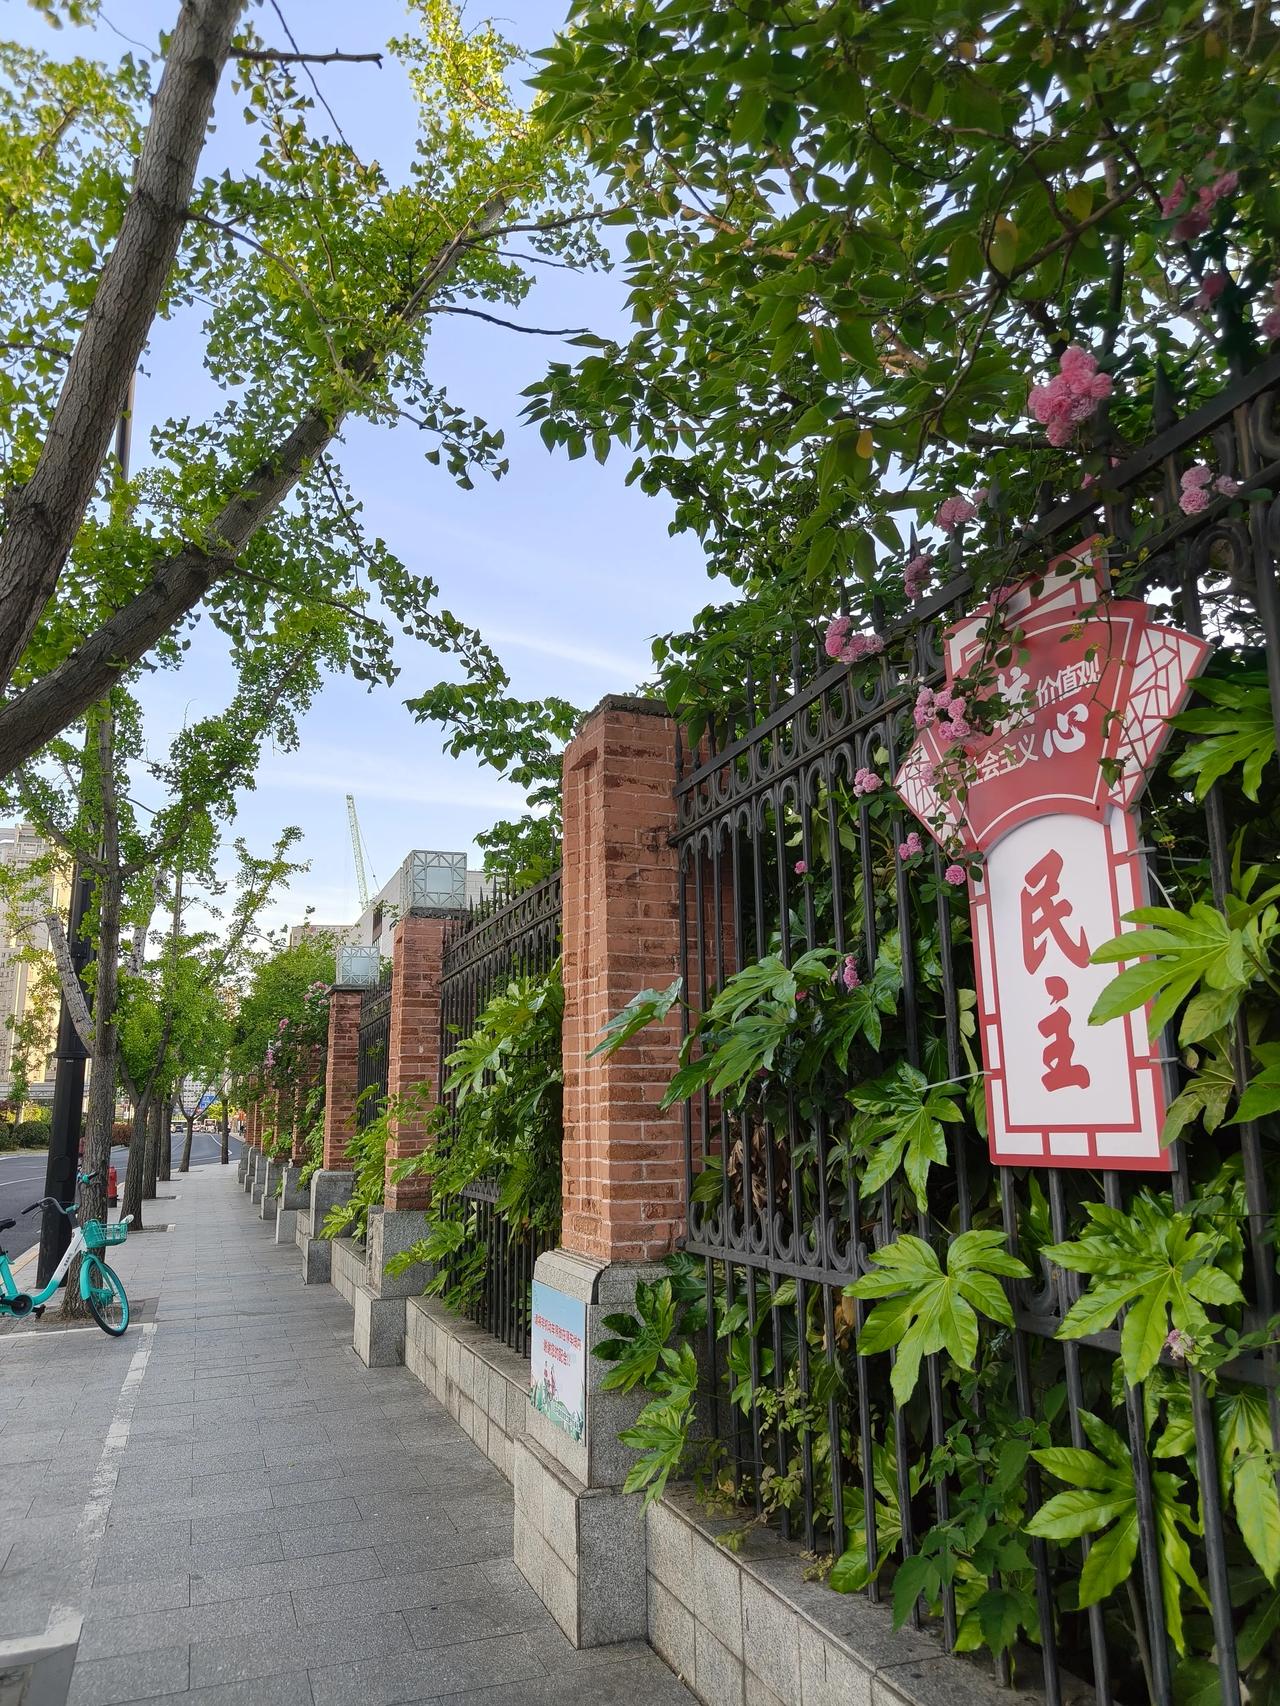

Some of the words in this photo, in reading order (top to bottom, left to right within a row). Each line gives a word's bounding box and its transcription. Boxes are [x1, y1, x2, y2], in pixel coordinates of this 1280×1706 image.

[1035, 652, 1102, 708] 价值观
[1020, 849, 1091, 1092] 民主
